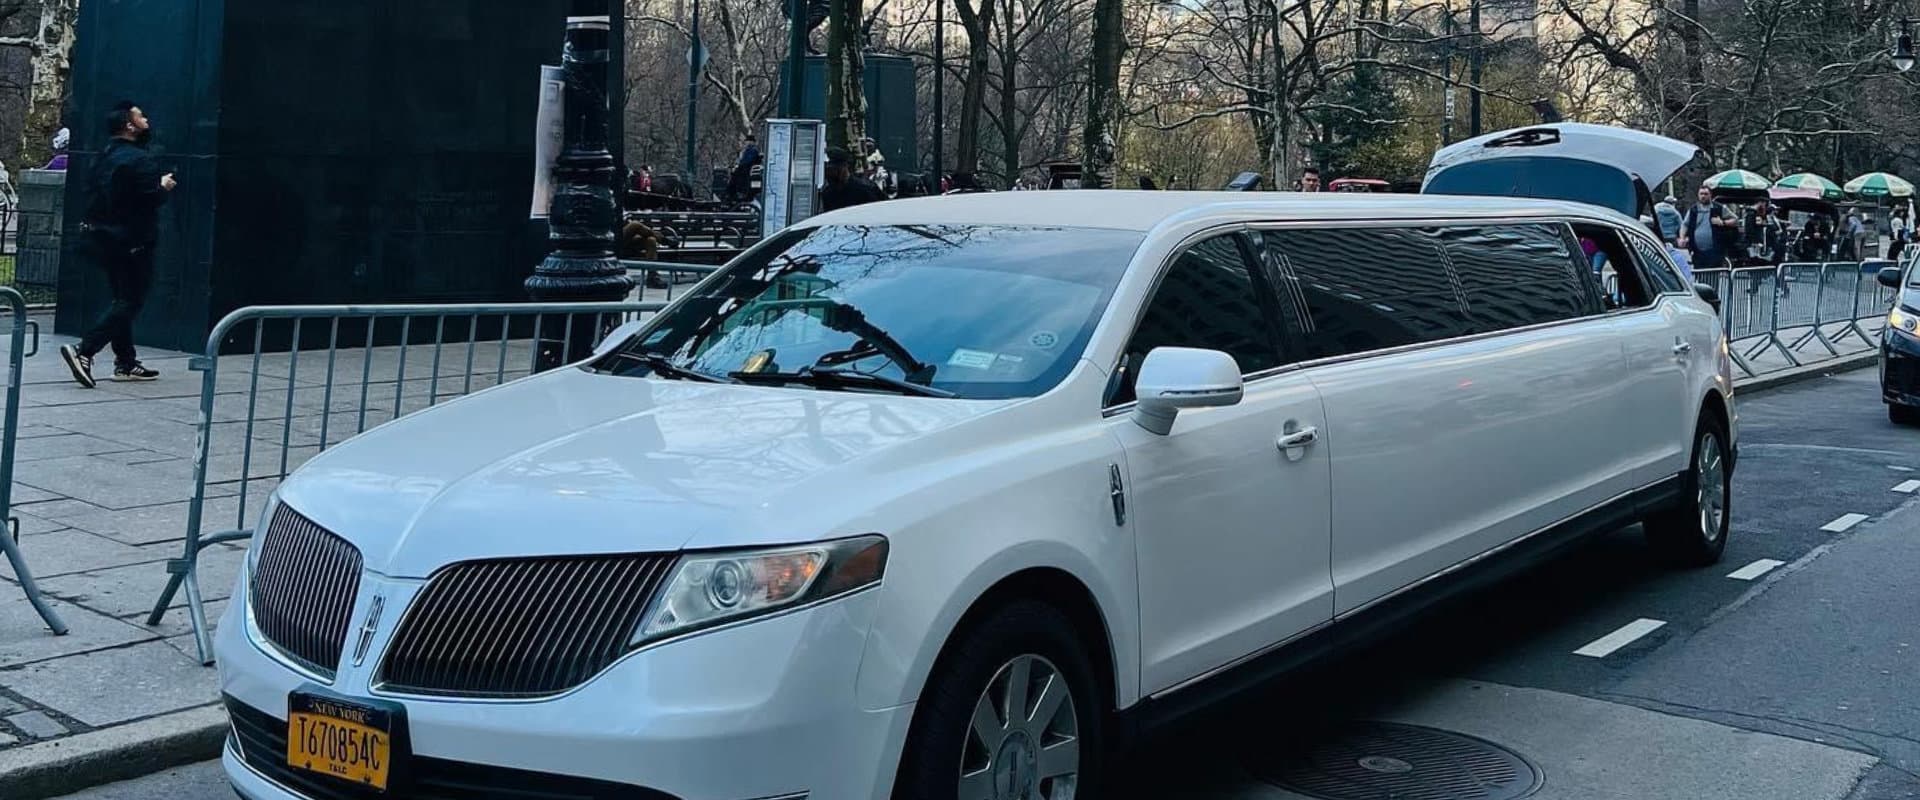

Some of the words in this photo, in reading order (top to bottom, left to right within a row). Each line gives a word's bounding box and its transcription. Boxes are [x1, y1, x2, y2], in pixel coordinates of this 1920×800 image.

[314, 702, 337, 717] NEW
[340, 707, 365, 722] YORK
[298, 716, 381, 770] T670854C
